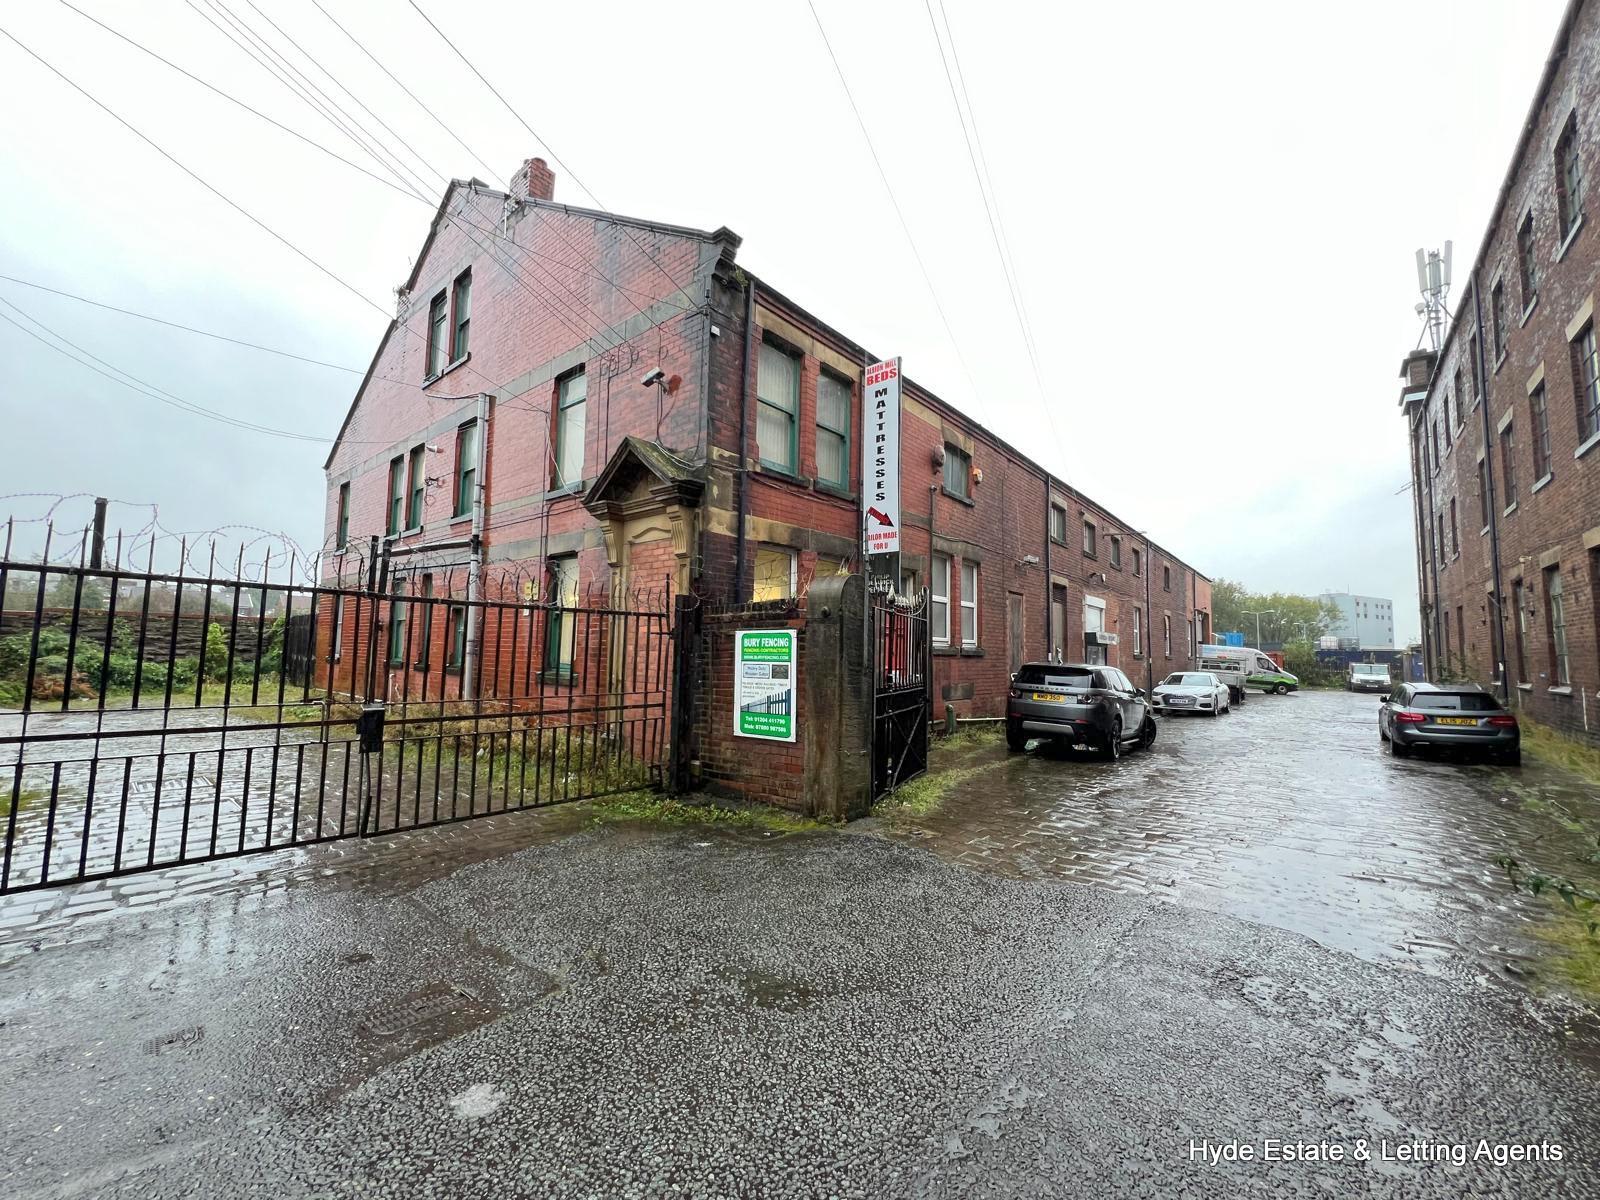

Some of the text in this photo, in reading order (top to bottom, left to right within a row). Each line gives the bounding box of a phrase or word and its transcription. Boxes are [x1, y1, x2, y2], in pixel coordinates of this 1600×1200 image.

[866, 368, 897, 386] BEDS
[874, 387, 888, 502] MATTRESSES
[868, 531, 897, 541] AILOR MADE
[744, 637, 789, 647] BURY FENCING
